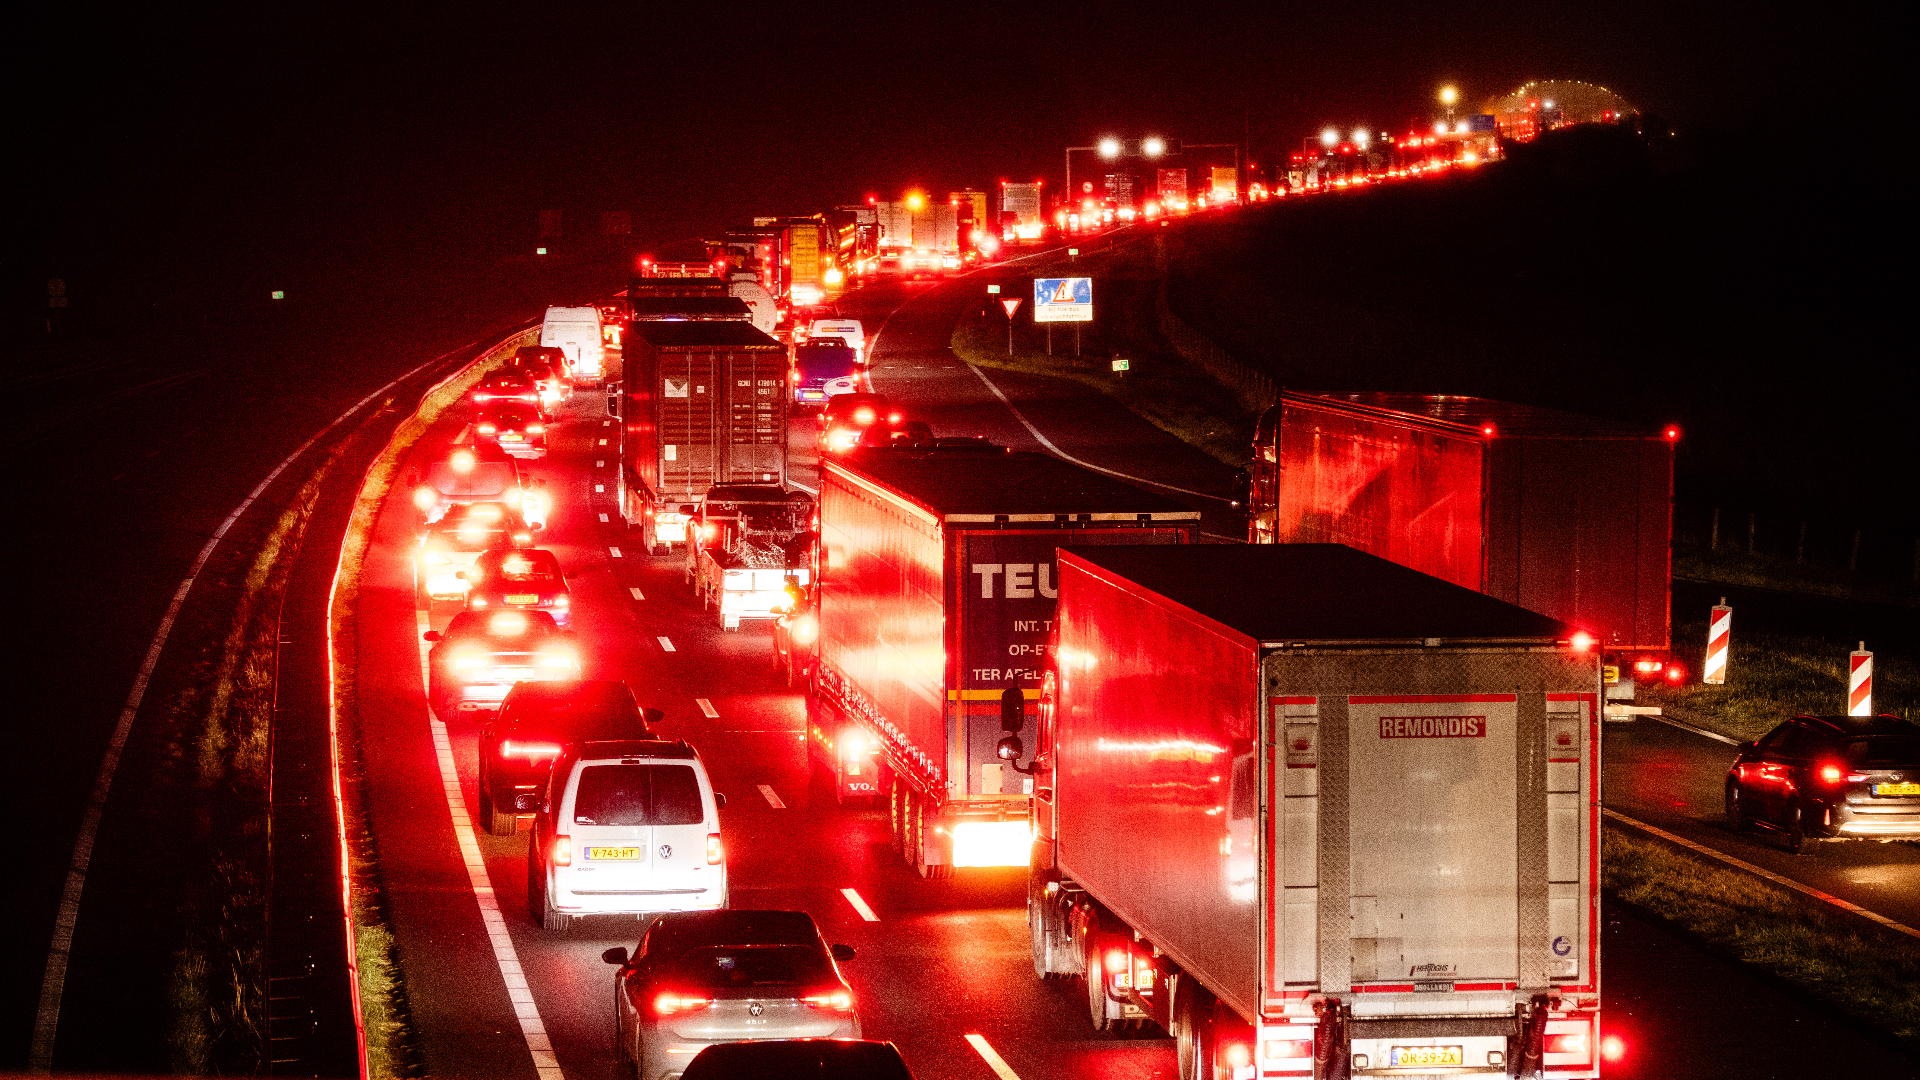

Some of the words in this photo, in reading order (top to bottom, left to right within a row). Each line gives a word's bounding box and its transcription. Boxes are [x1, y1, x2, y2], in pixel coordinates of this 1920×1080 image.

[1014, 620, 1040, 632] INT.
[972, 668, 1001, 681] TER
[592, 848, 635, 858] V-743-HT
[1401, 1052, 1456, 1063] OR-39-ZX
